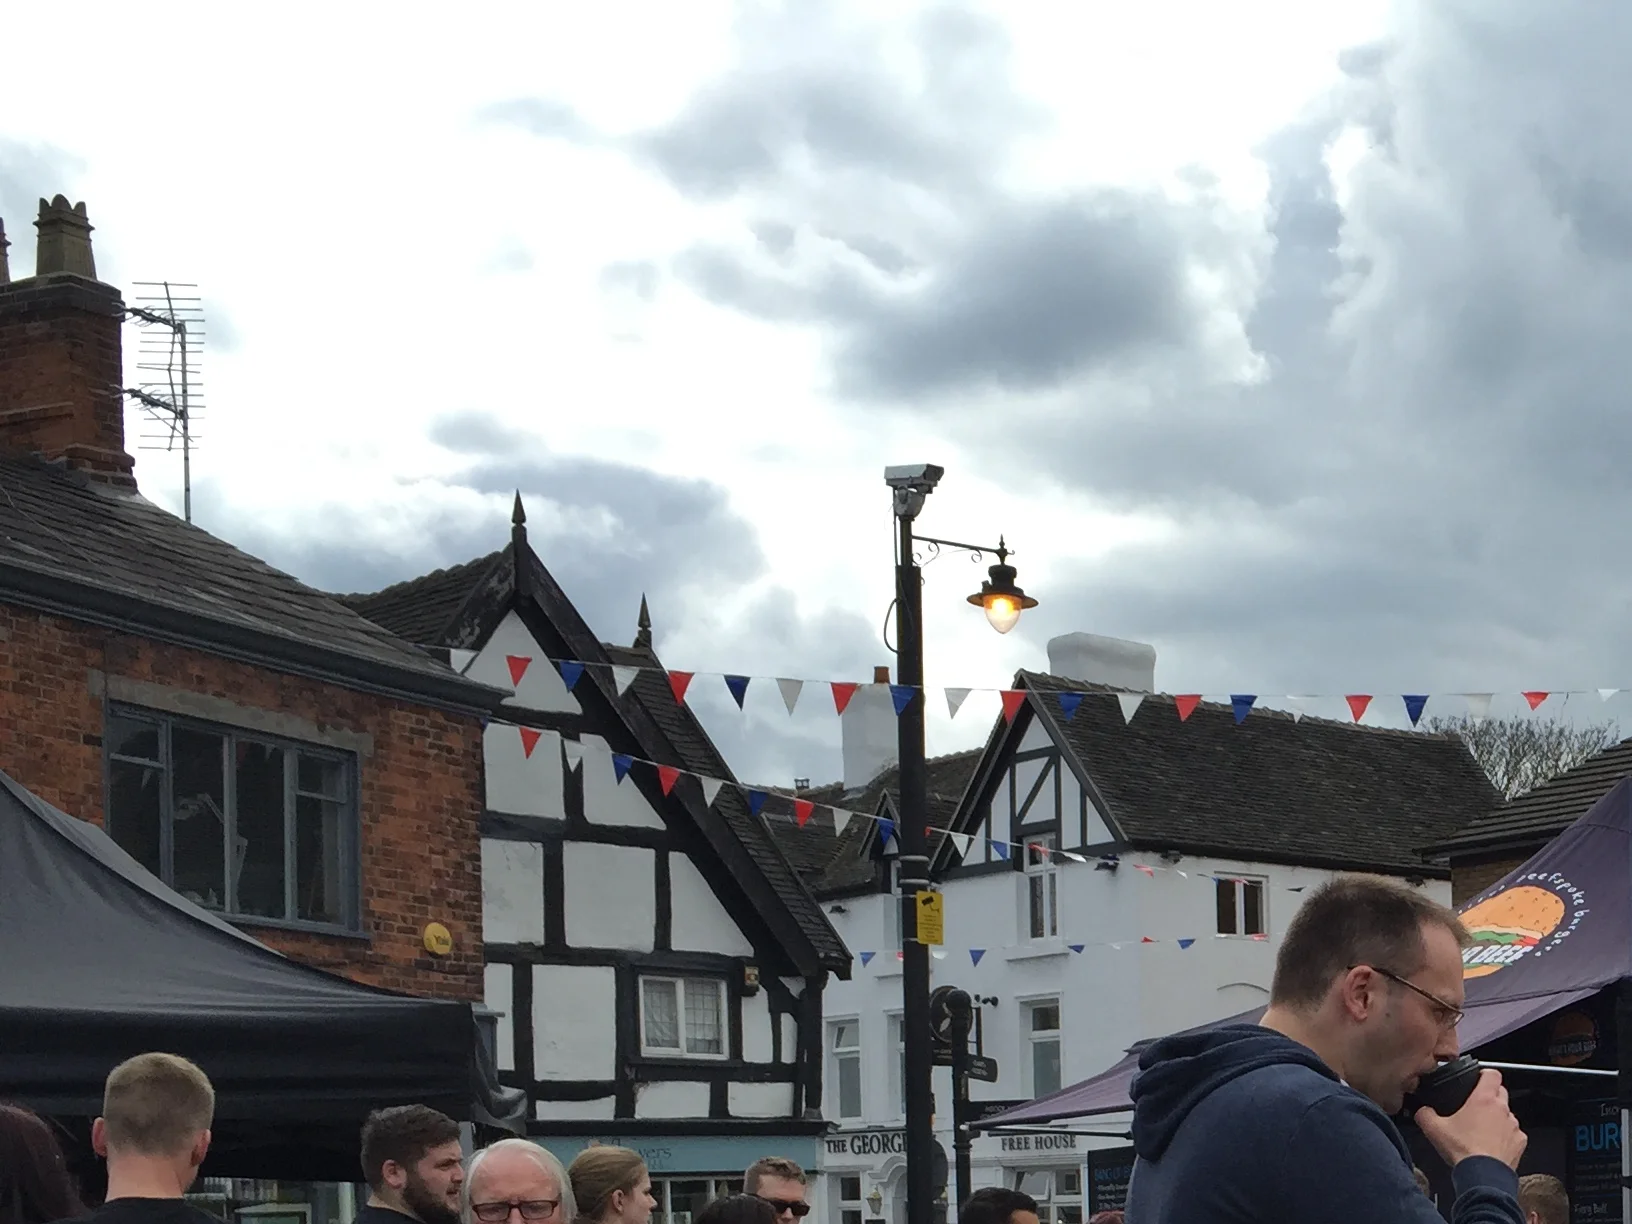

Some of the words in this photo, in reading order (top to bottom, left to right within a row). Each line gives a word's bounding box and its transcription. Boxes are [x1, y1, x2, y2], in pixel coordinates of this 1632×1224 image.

[1001, 1136, 1030, 1152] FREE
[1035, 1134, 1077, 1150] HOUSE
[1576, 1122, 1622, 1152] BUR
[826, 1139, 848, 1154] THE
